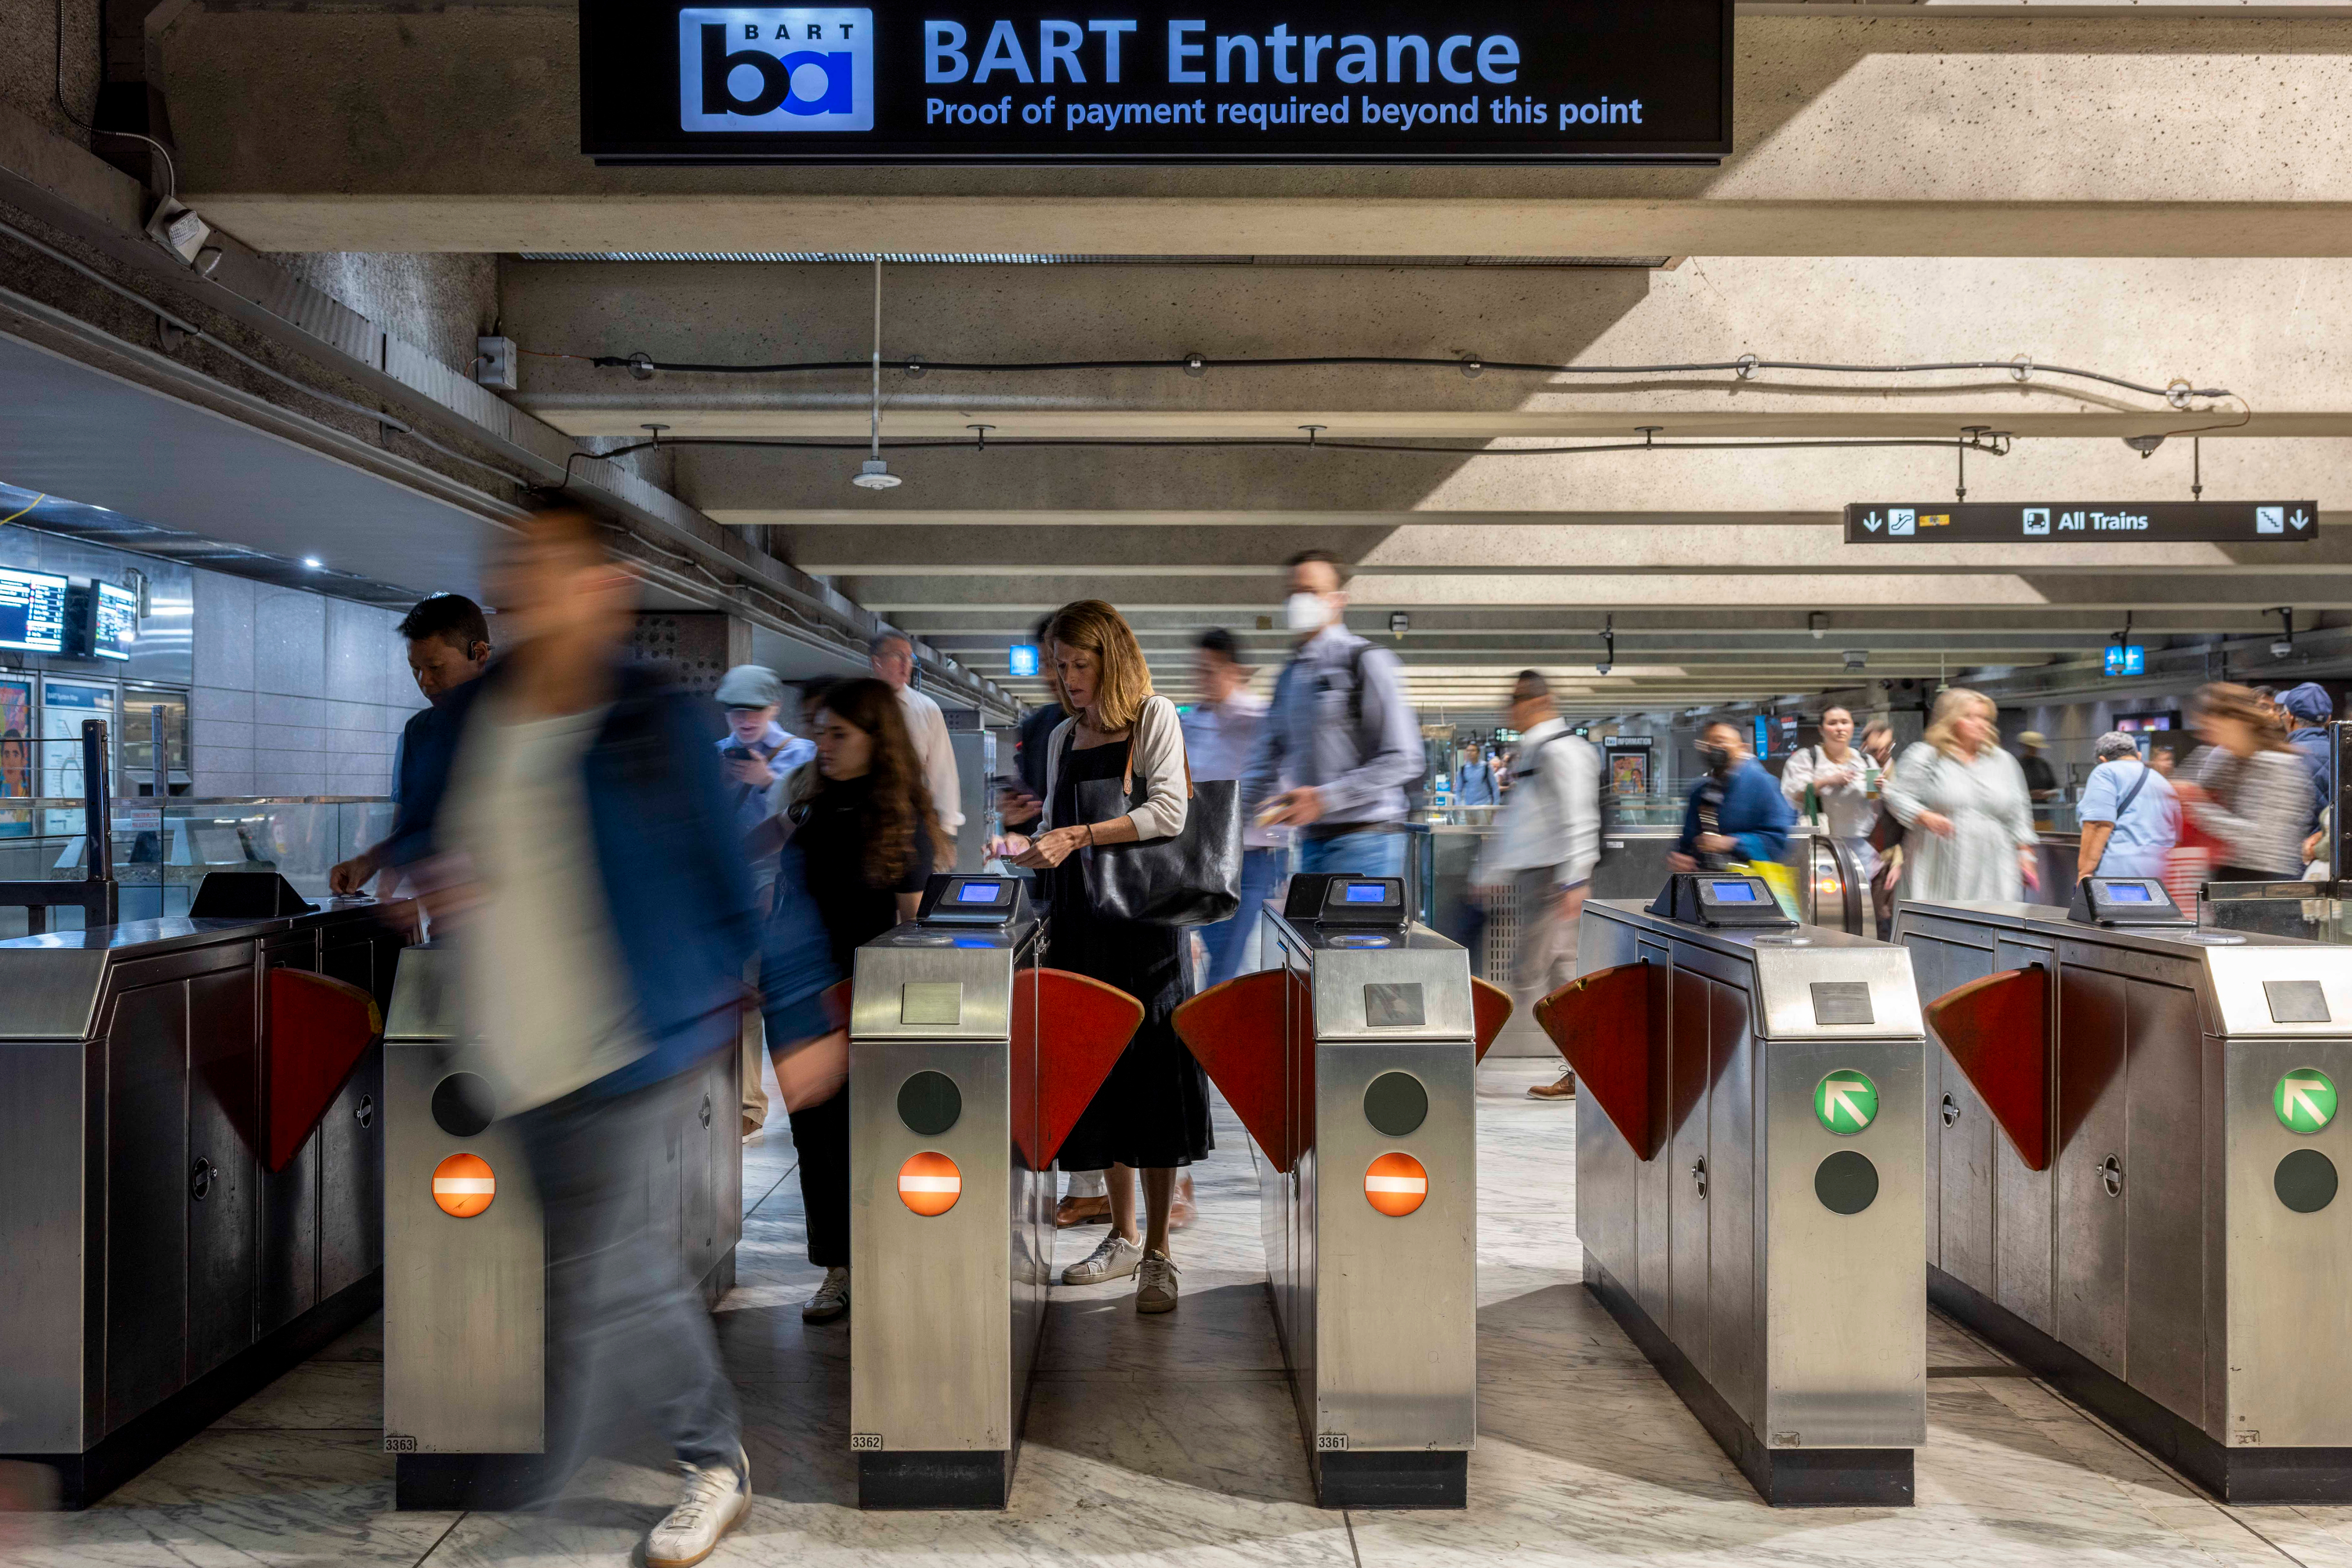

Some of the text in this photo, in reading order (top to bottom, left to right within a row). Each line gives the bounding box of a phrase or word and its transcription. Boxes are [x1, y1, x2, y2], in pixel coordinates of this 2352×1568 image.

[745, 24, 854, 40] BART
[925, 20, 1520, 83] BART Entrance
[927, 96, 1642, 131] Proof of payment required beyond this point
[2057, 511, 2149, 531] All Trains
[386, 1439, 413, 1451] 3363
[852, 1436, 880, 1448] 3362
[1319, 1436, 1345, 1448] 3361
